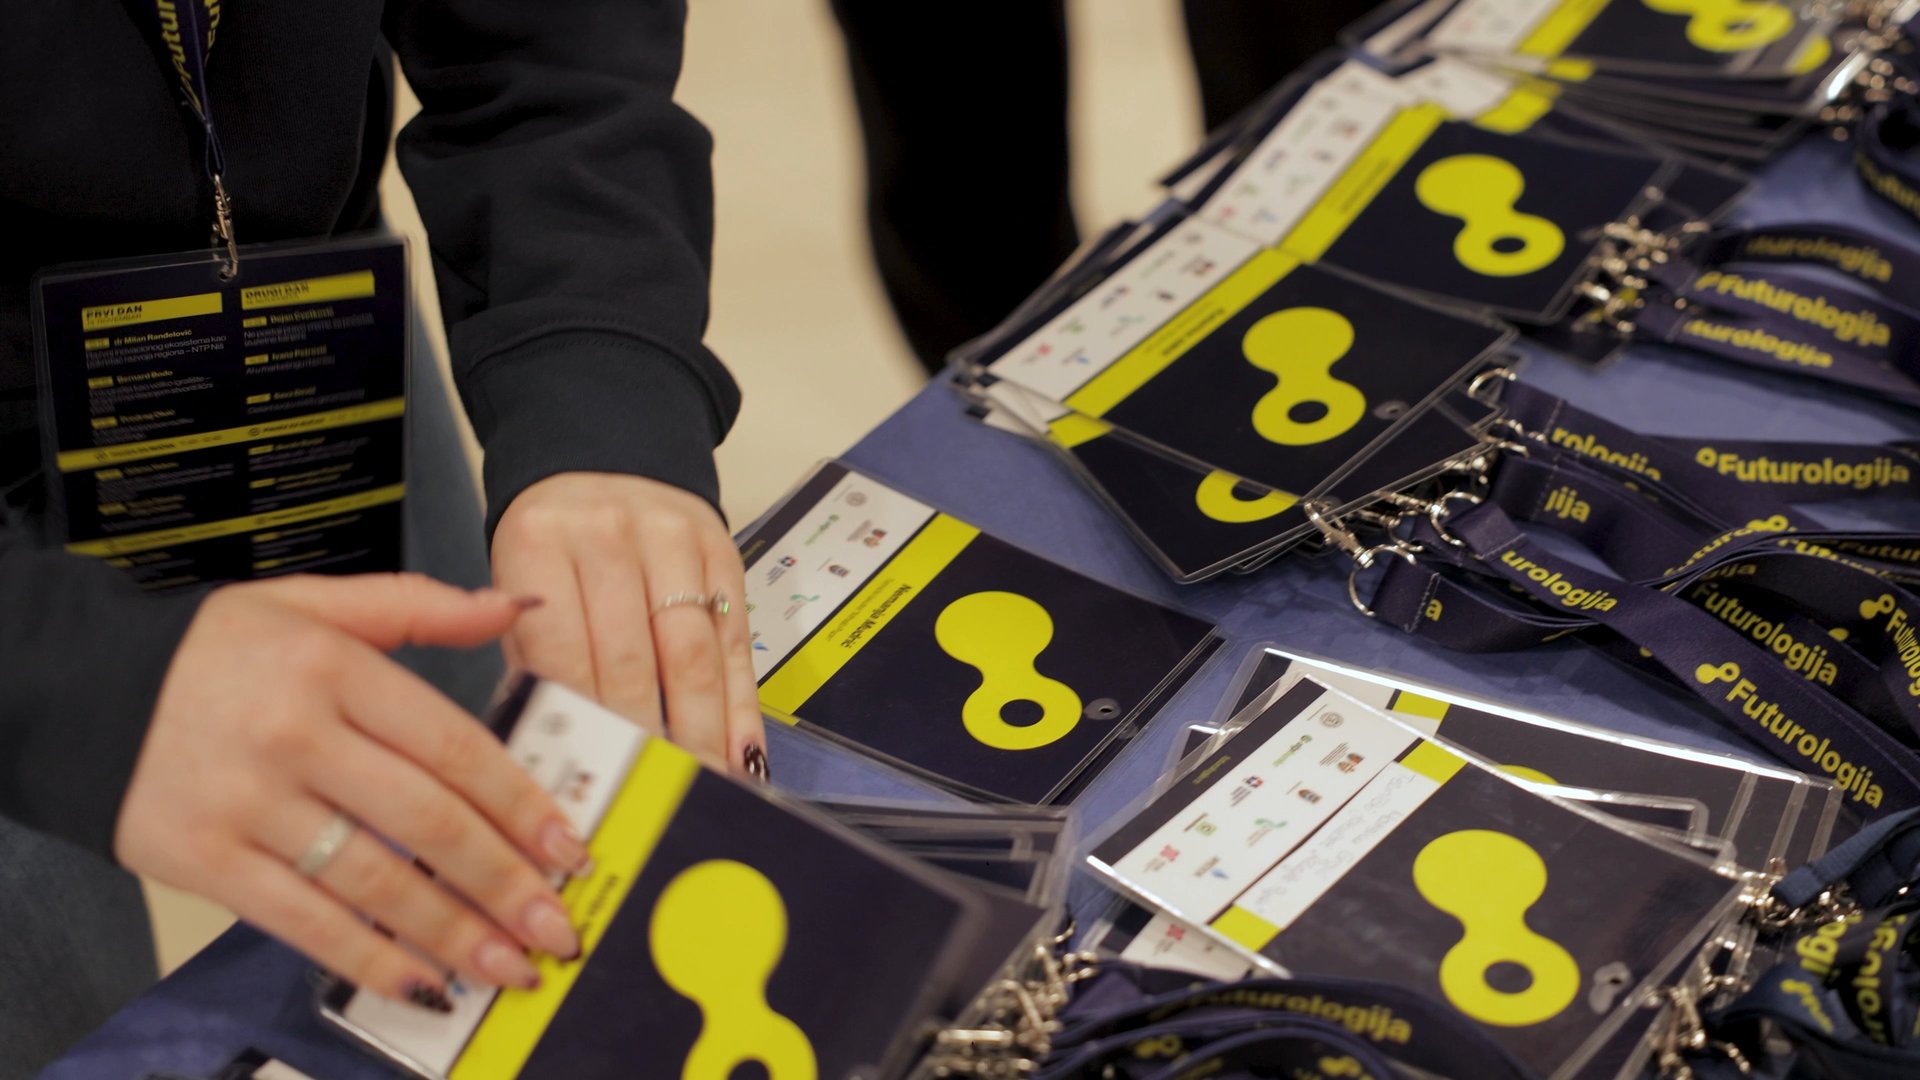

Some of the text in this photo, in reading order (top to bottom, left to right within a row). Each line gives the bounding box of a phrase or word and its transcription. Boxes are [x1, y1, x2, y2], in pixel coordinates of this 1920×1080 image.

[1717, 451, 1911, 490] Futurologija
[1500, 550, 1618, 611] urologija
[1690, 581, 1839, 687] Futurologija
[1725, 677, 1885, 810] Futurologija
